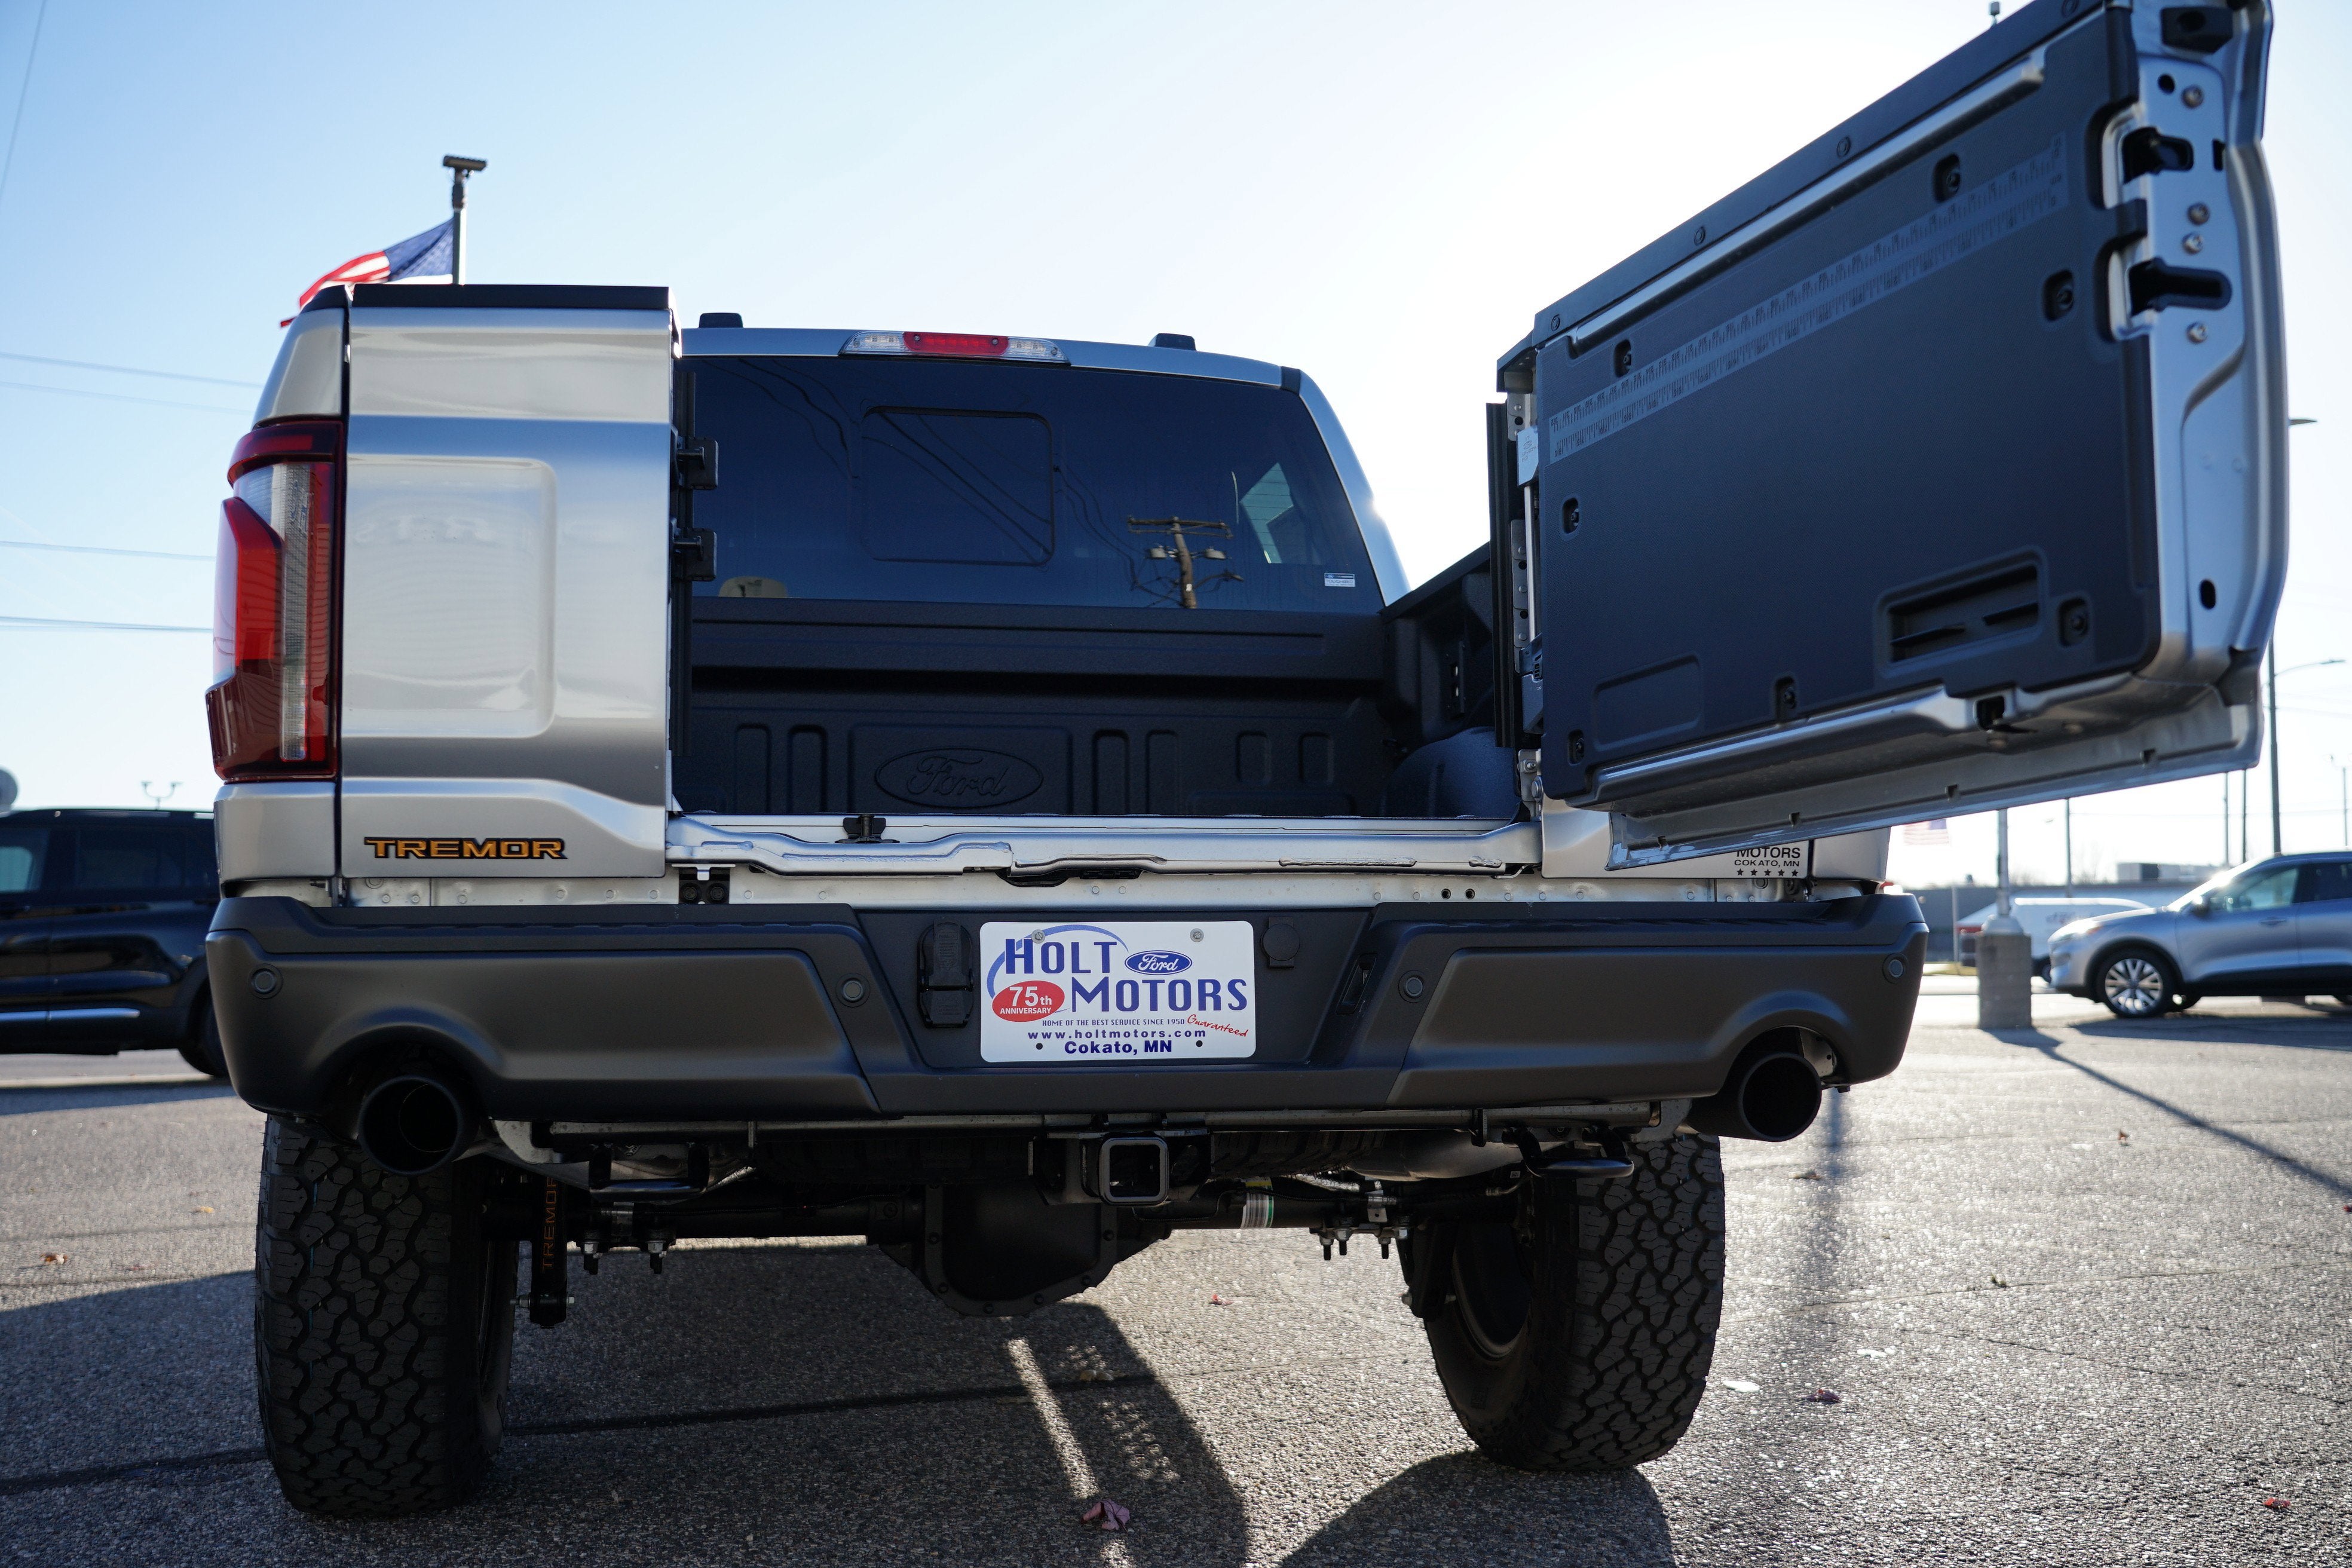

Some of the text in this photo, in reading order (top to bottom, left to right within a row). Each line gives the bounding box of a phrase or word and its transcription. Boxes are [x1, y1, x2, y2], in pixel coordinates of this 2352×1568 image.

[906, 755, 1009, 796] Ford
[363, 836, 568, 859] TREMOR
[1736, 847, 1800, 858] MOTORS
[1734, 859, 1781, 868] COKATO,
[1005, 938, 1117, 974] HOLT
[1138, 954, 1180, 971] Ford
[1009, 986, 1052, 1007] 75th
[1071, 976, 1247, 1012] MOTORS
[1027, 1029, 1206, 1039] www.holtmotors.com
[1187, 1013, 1249, 1037] Guaranteed
[1064, 1040, 1172, 1055] Cokato, MN
